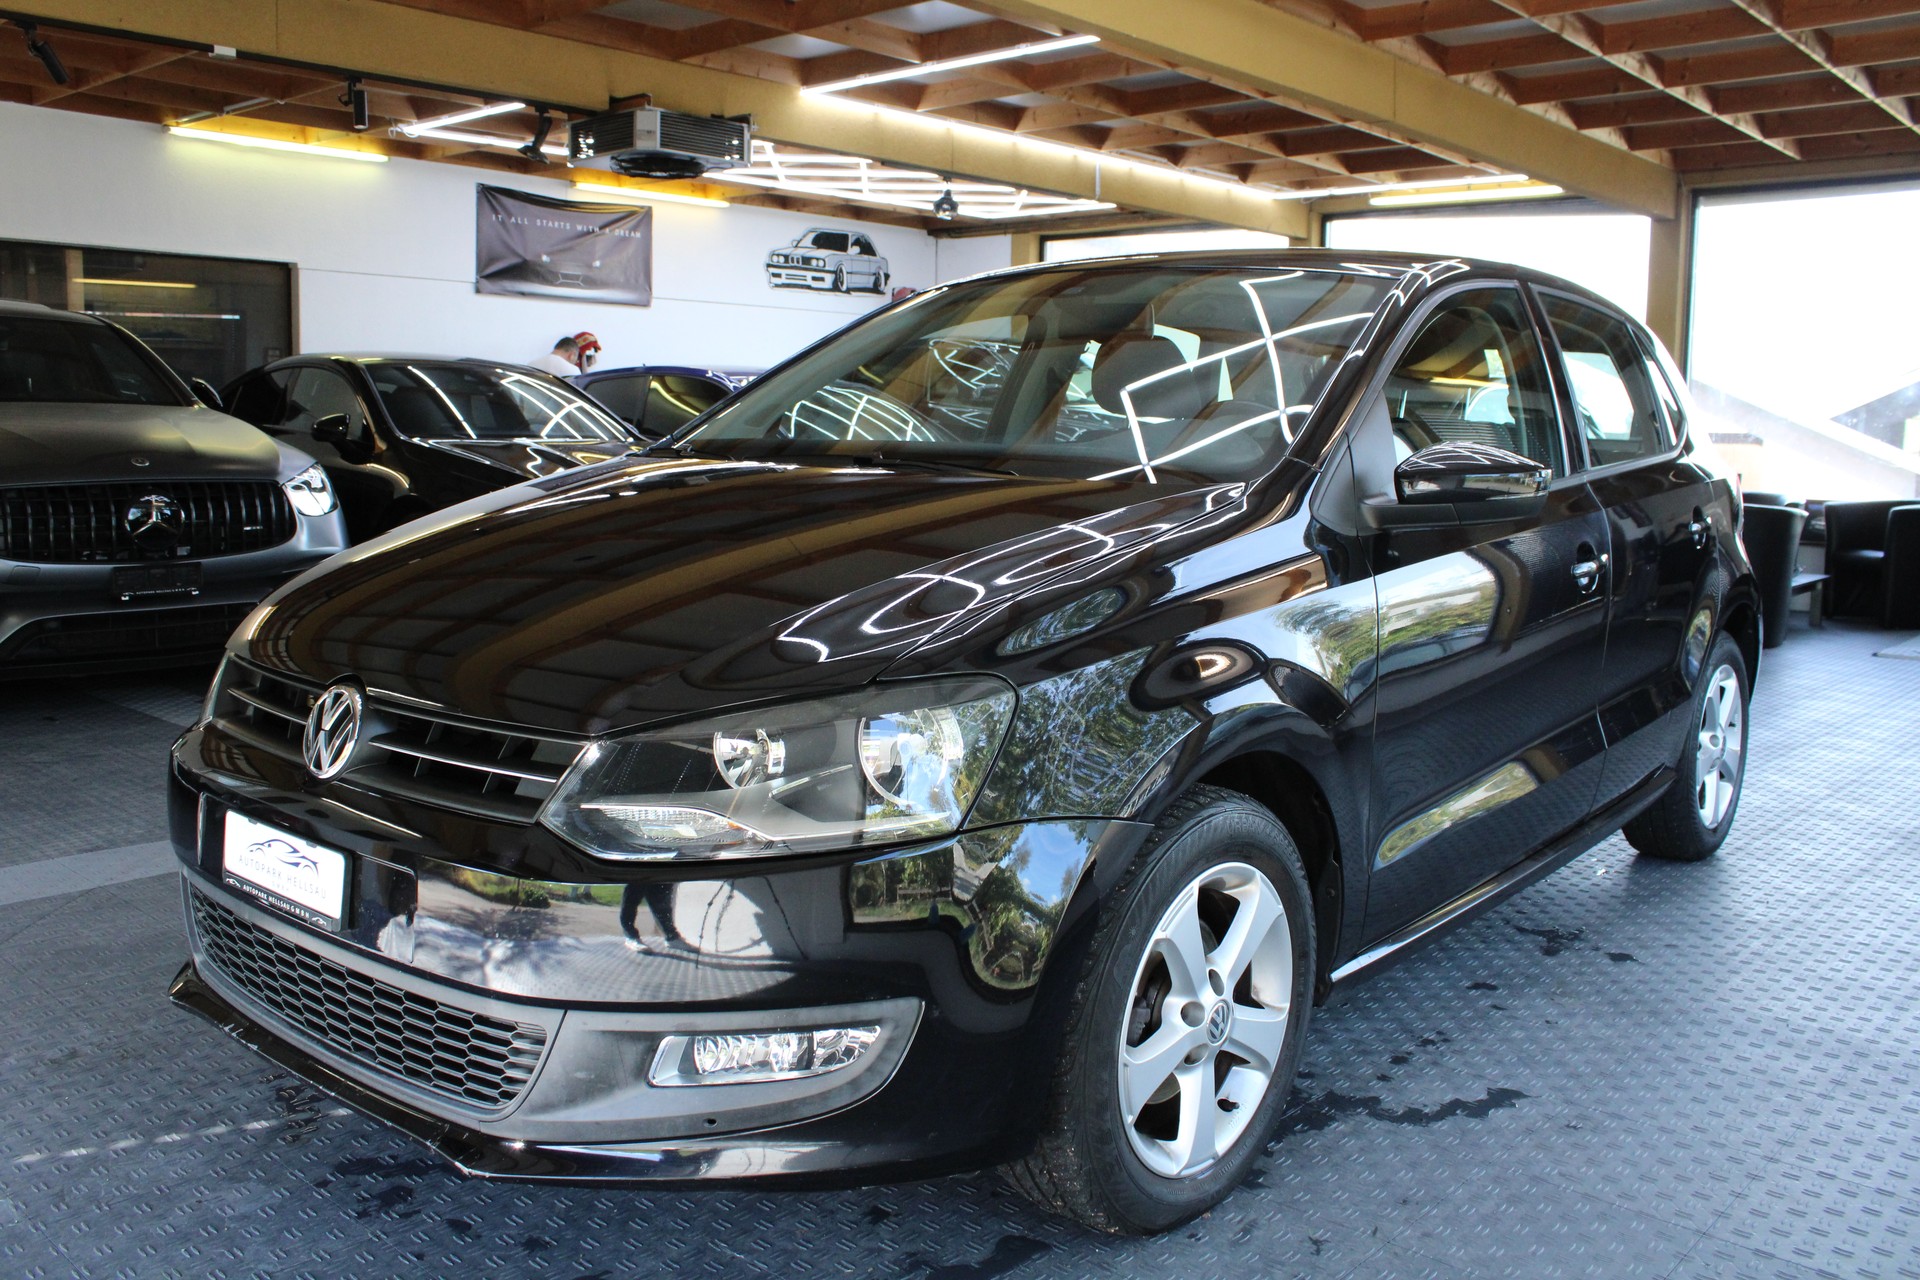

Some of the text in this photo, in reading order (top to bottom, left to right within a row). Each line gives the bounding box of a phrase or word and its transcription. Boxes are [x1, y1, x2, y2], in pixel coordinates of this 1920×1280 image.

[492, 213, 503, 222] IT
[510, 215, 528, 225] ALL
[536, 219, 571, 230] STARTS
[576, 223, 600, 233] WITH
[614, 229, 641, 239] DREAM
[239, 855, 282, 880] AUTOPARK
[287, 877, 326, 899] HELLSAU
[243, 884, 268, 900] AUTOPARK
[268, 895, 290, 911] HELLSAU
